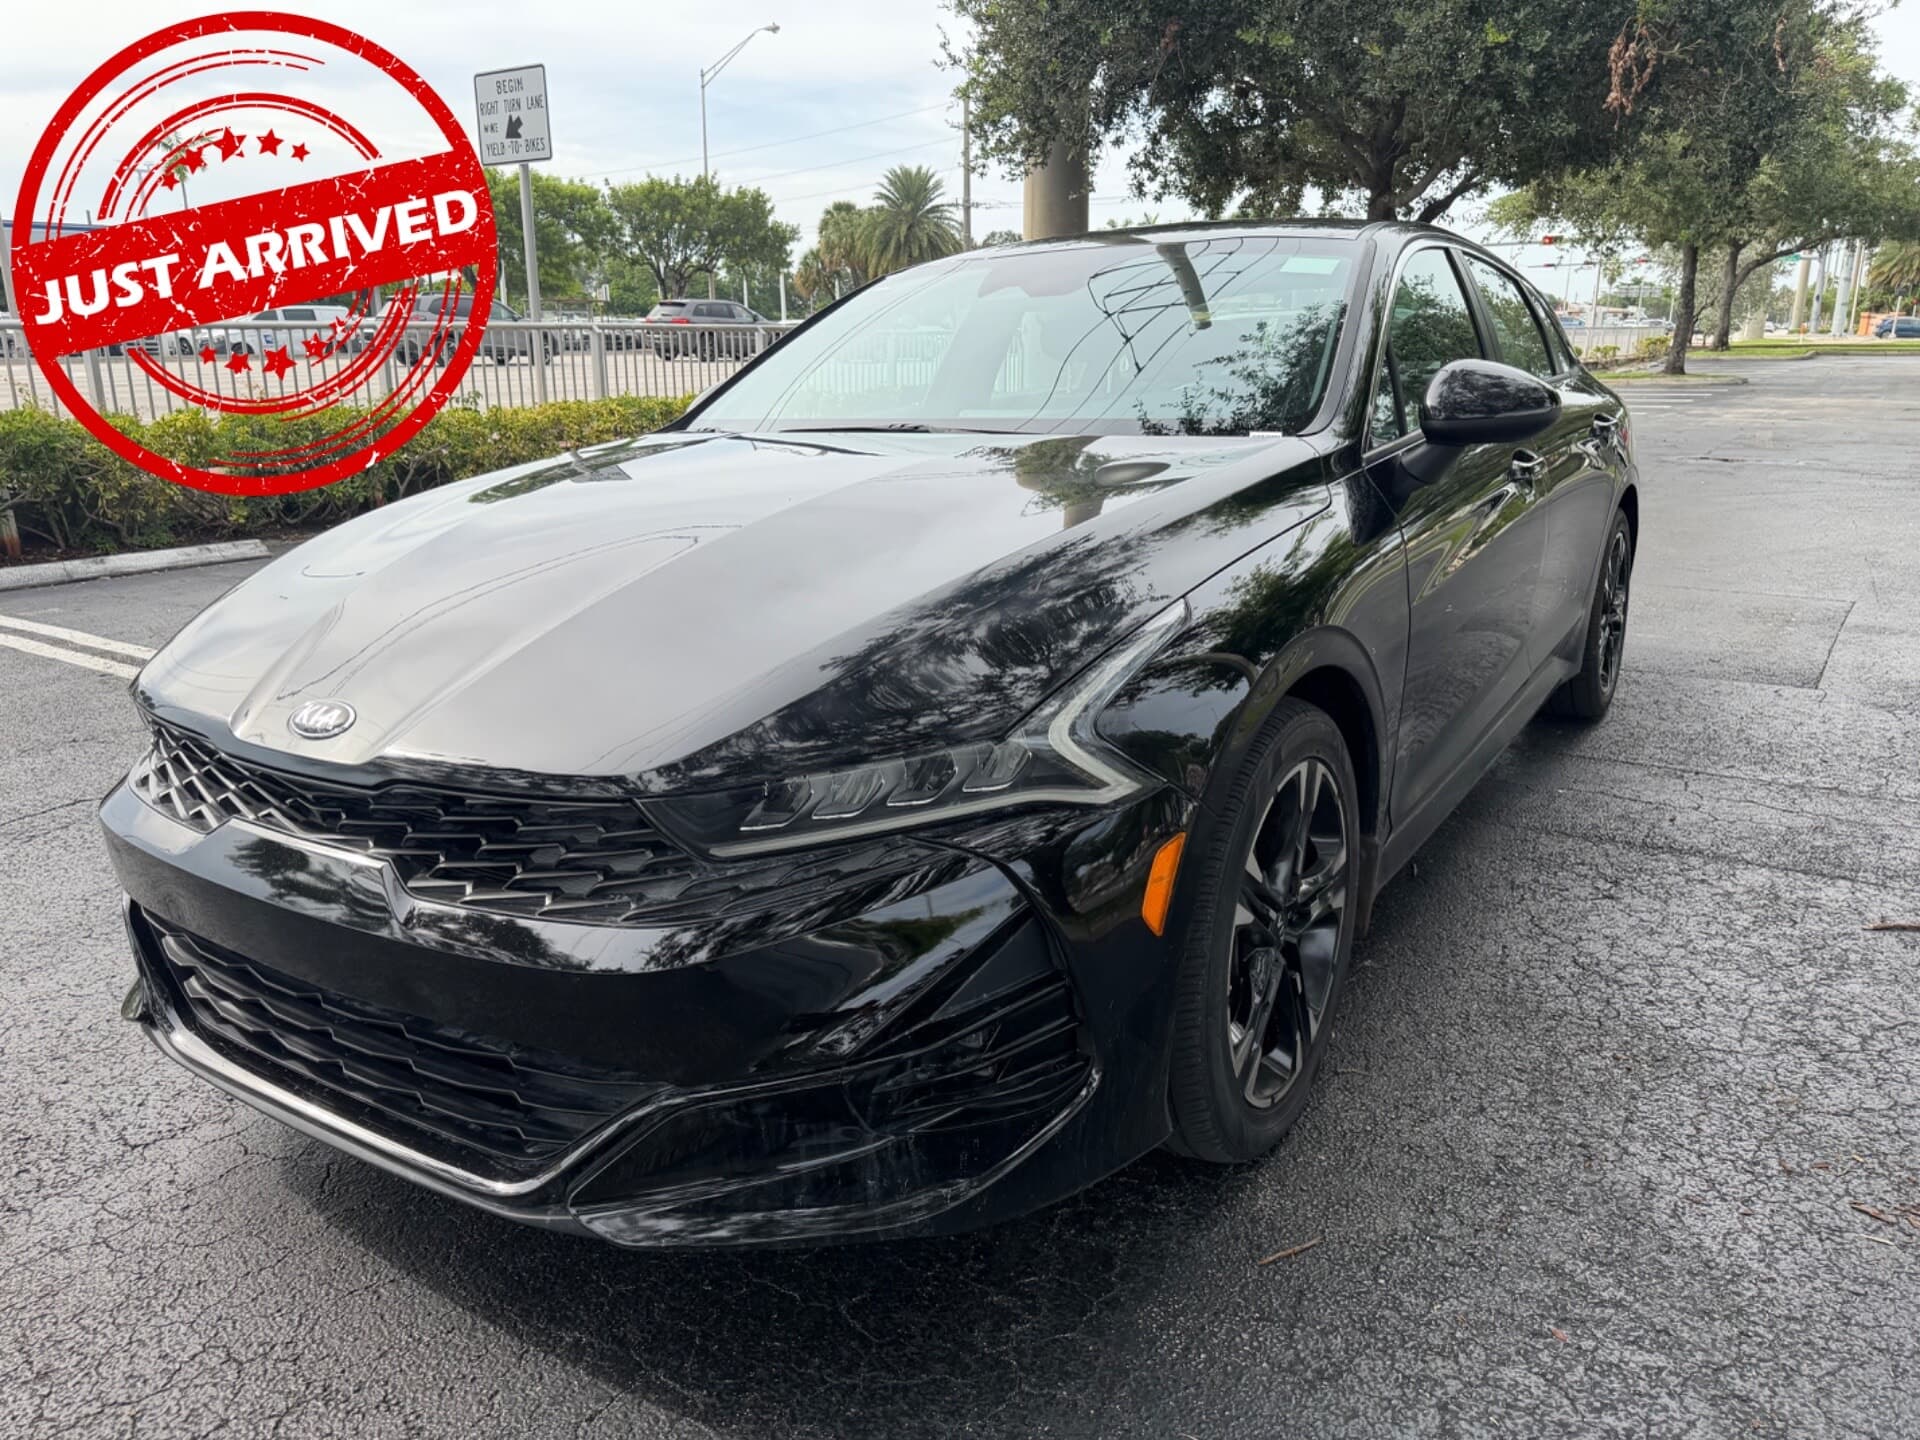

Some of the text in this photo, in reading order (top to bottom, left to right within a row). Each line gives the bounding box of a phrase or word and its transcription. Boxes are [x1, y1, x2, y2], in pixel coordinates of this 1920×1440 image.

[496, 77, 524, 95] BEGIN
[480, 94, 544, 116] RIGHT TURN LANE
[486, 142, 505, 157] YIELD
[525, 137, 546, 153] BIKES
[293, 702, 343, 731] KIA
